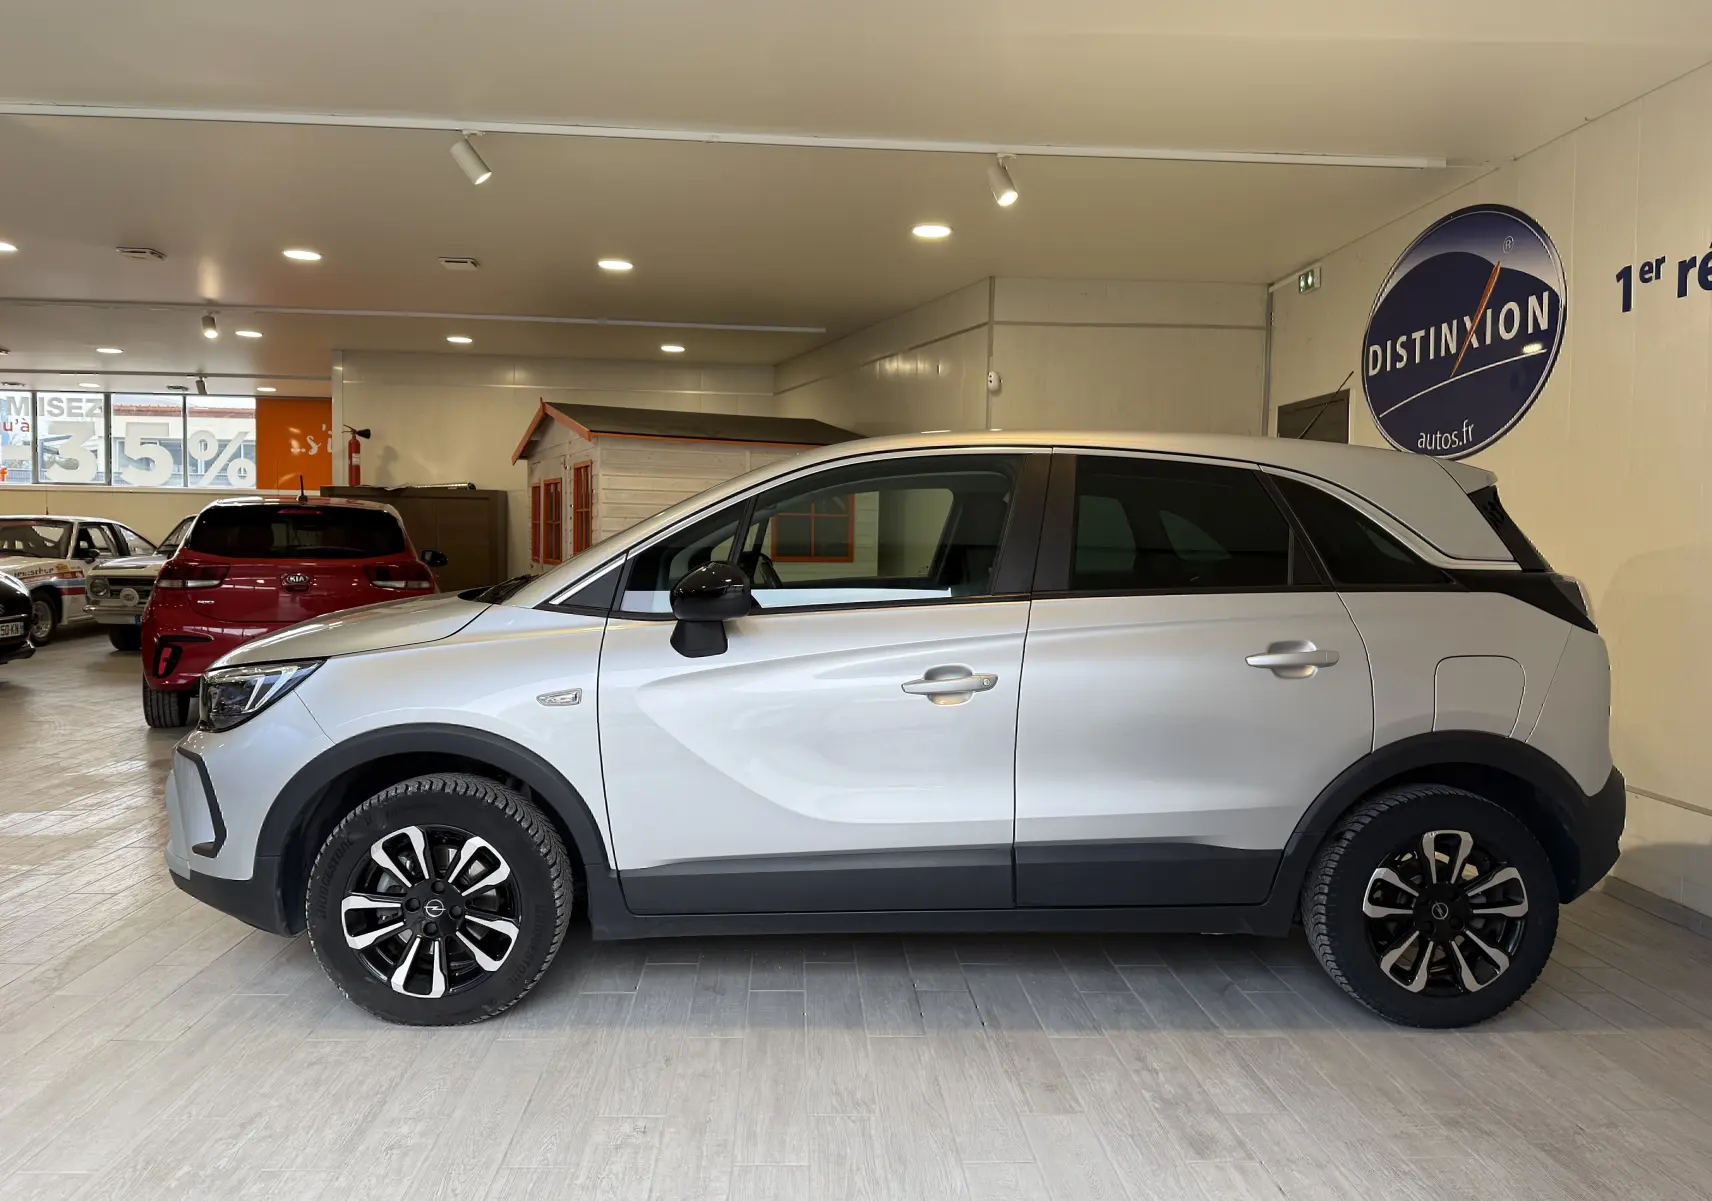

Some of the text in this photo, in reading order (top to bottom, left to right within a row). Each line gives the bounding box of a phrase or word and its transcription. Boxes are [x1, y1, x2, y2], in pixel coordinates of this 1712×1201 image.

[1615, 254, 1666, 313] 1er
[1368, 291, 1550, 377] DISTINXION
[1417, 419, 1475, 450] autos.fr
